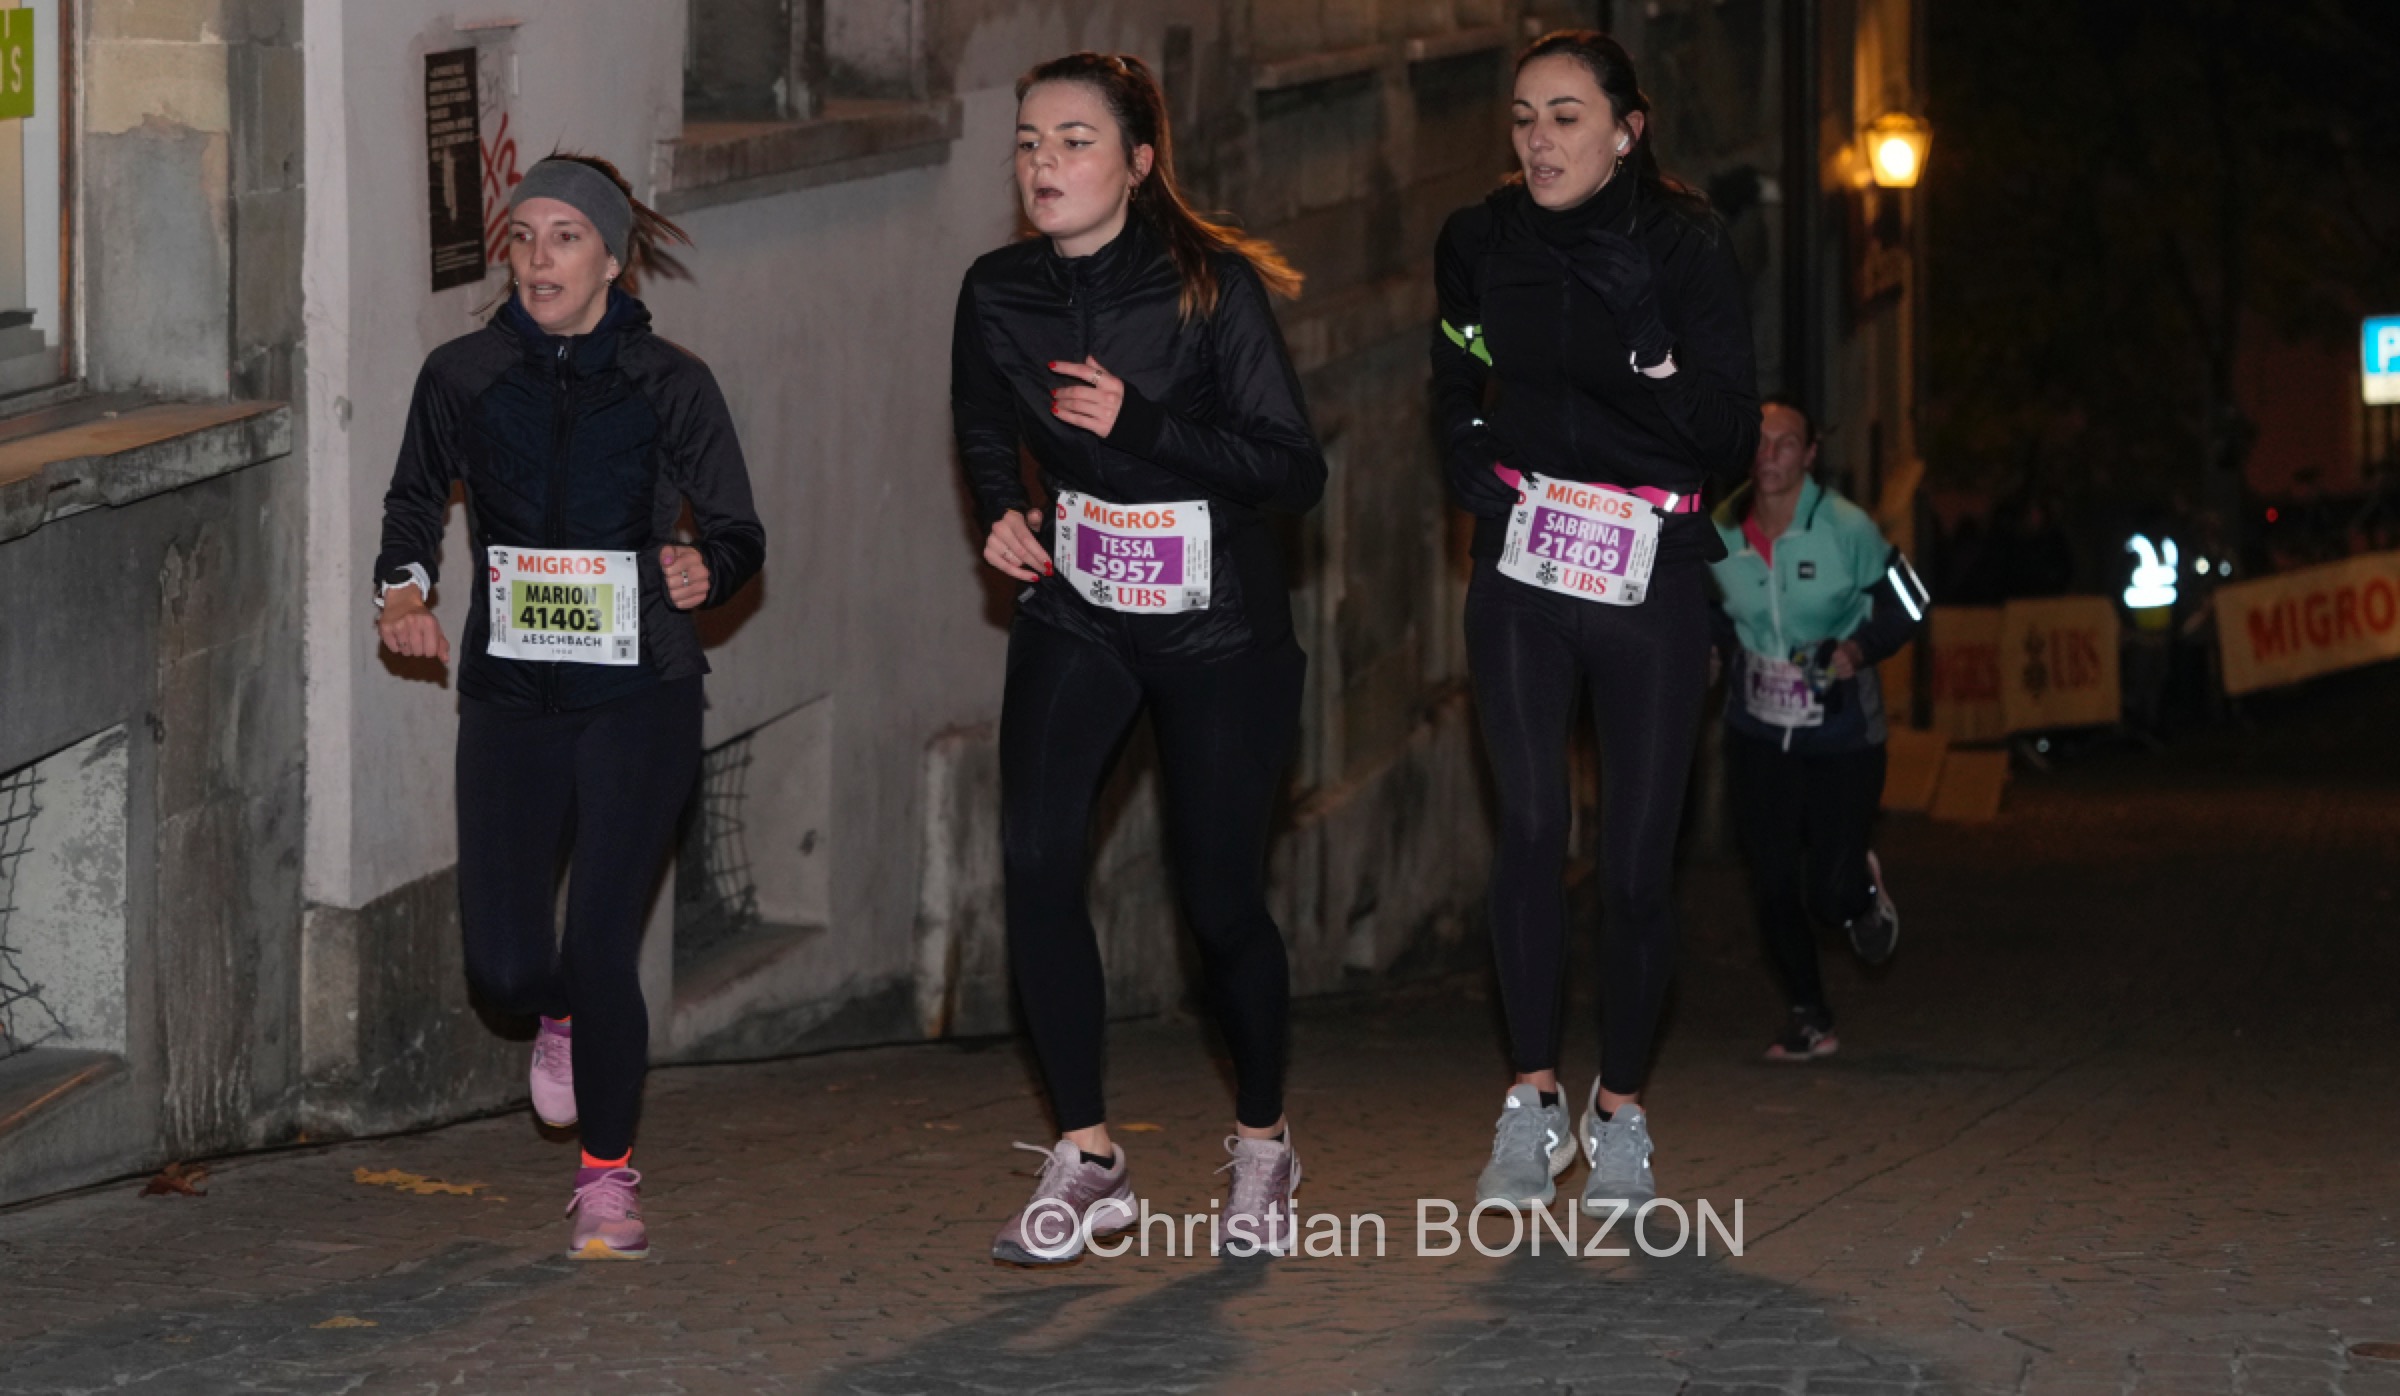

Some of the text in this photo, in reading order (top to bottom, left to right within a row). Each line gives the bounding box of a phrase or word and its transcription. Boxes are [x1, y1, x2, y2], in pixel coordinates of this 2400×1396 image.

[1083, 501, 1177, 529] MIGROS
[1545, 483, 1633, 519] MIGROS
[1543, 512, 1619, 547] SABRINA
[1099, 535, 1155, 559] TESSA
[1535, 532, 1620, 571] 21409
[517, 553, 607, 575] MIGROS
[1091, 553, 1165, 583] 5957
[525, 583, 597, 605] MARION
[1562, 567, 1608, 595] UBS
[1116, 586, 1167, 608] UBS
[519, 606, 603, 632] 41403
[2247, 576, 2400, 664] MIGRO
[522, 634, 602, 648] AESCHBACH
